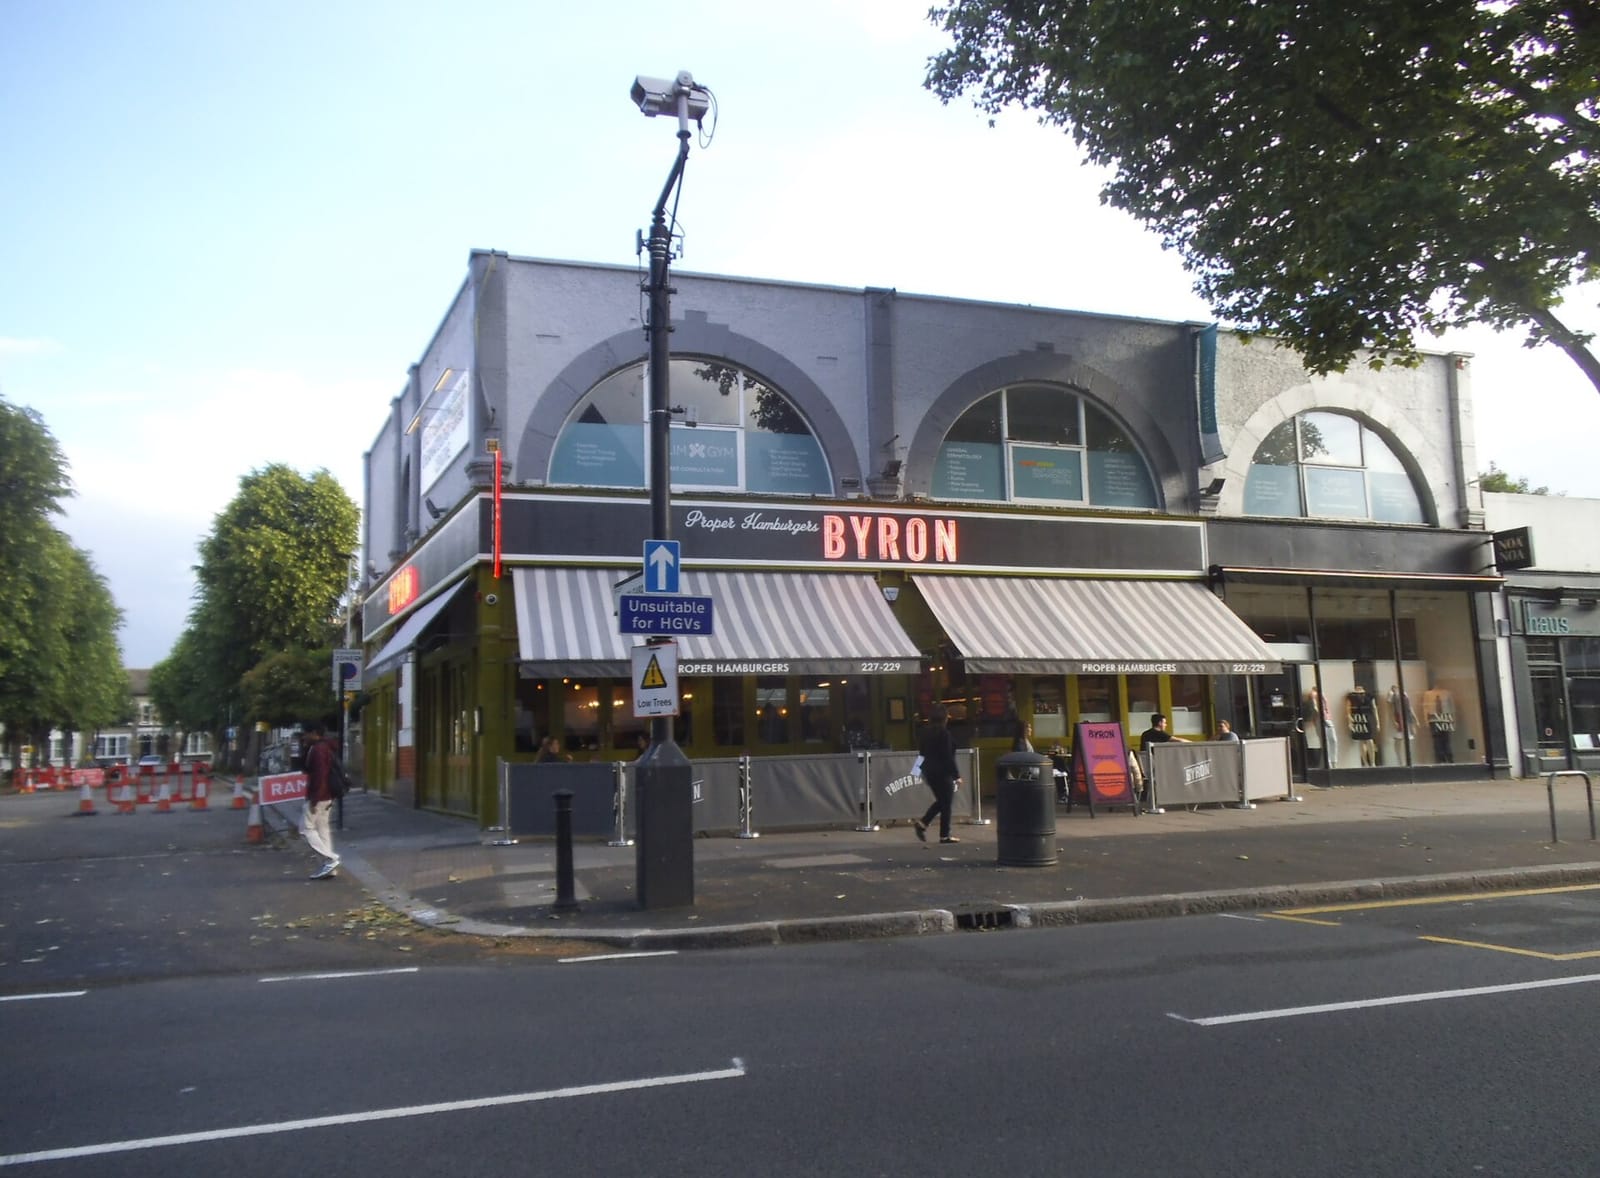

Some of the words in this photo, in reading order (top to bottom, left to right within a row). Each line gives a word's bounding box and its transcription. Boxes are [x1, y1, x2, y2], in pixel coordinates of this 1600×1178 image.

[685, 510, 735, 532] Proper
[741, 512, 819, 536] Hamburgers
[823, 514, 957, 563] BYRON
[629, 600, 705, 613] Unsuitable
[632, 617, 653, 629] for
[660, 618, 701, 630] HGVs
[678, 663, 714, 673] ROPER
[716, 663, 789, 673] HAMBURGERS
[861, 663, 901, 672] 227-229
[1082, 663, 1116, 673] PROPER
[1118, 663, 1177, 673] HAMBURGERS
[1233, 664, 1265, 672] 227-229
[637, 699, 651, 708] Low
[653, 698, 672, 707] Trees
[1350, 714, 1368, 723] NOA
[1088, 729, 1115, 739] BYRON
[1350, 724, 1368, 733] NOA
[1185, 762, 1210, 782] BYRON
[884, 775, 913, 796] PROPER
